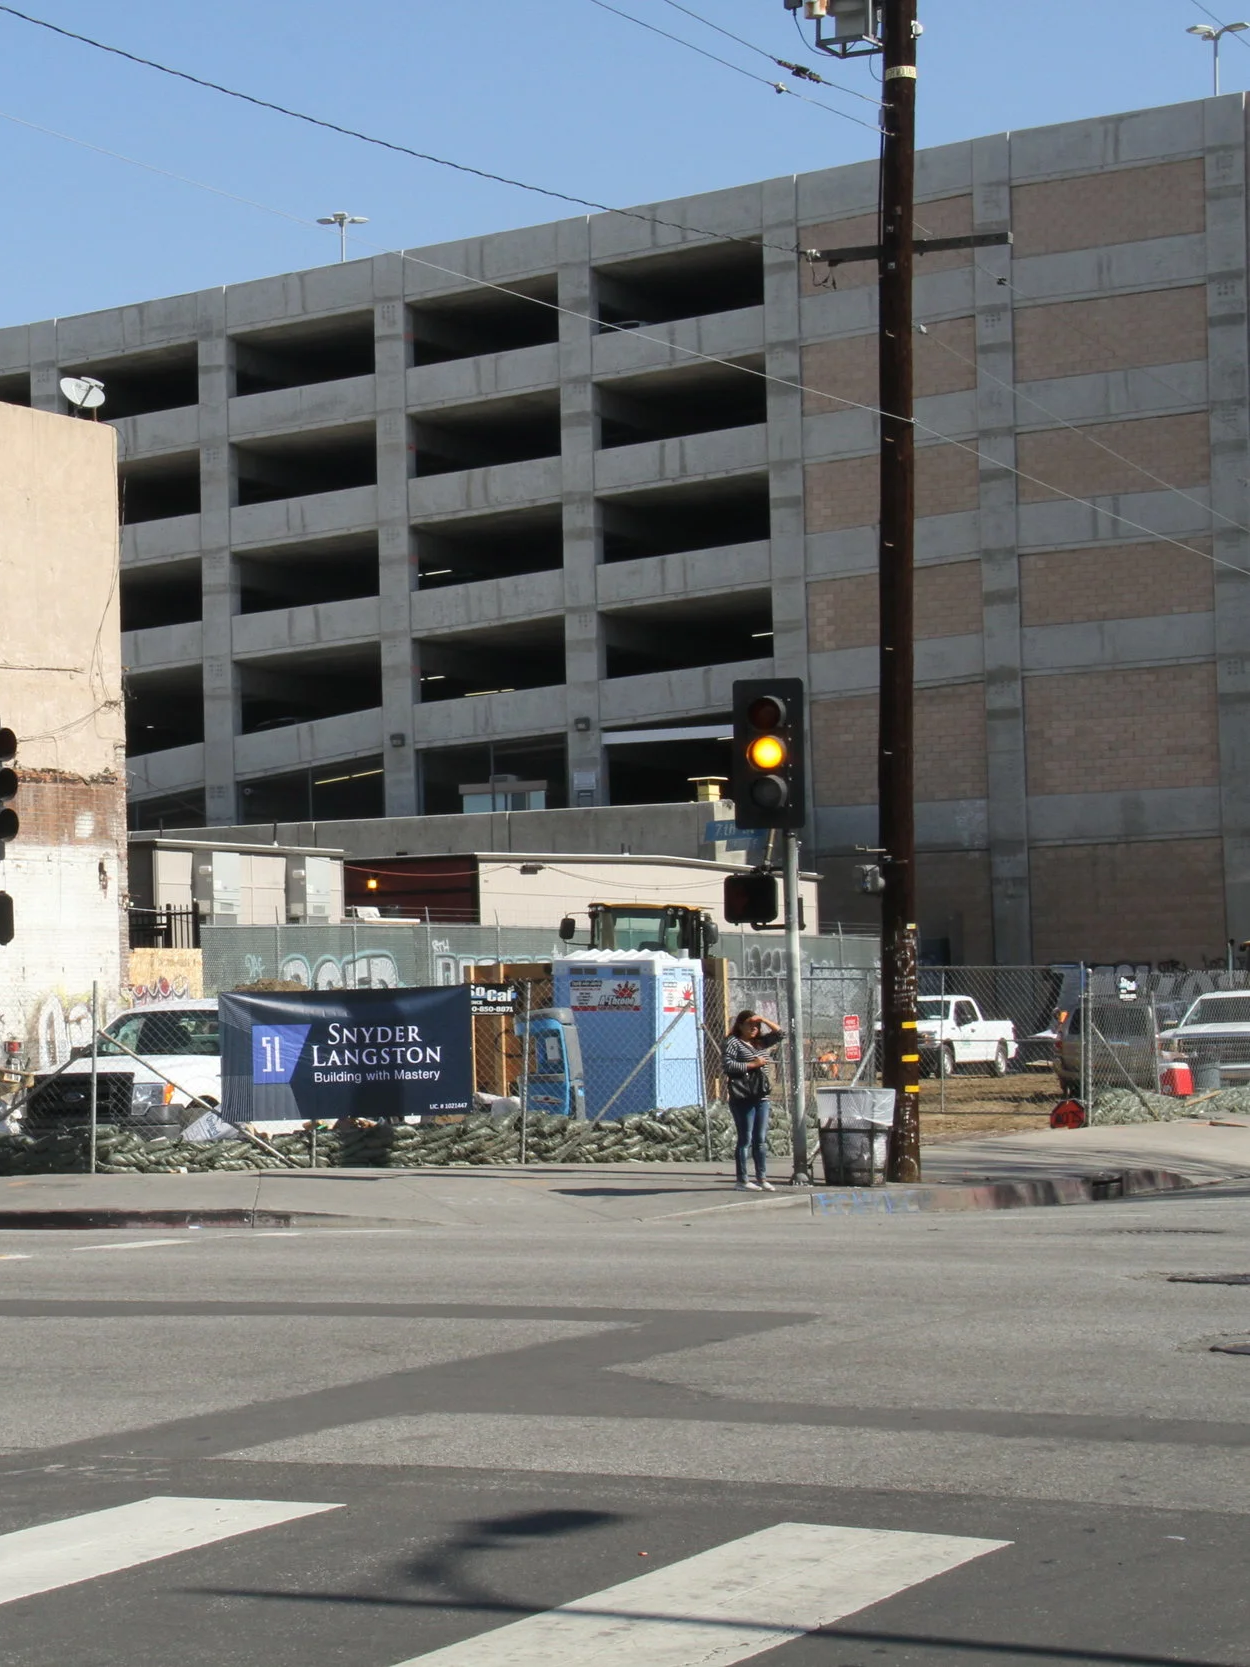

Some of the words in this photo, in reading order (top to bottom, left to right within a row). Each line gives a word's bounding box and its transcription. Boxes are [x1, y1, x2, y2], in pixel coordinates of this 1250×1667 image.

[312, 1045, 441, 1067] LANGSTON
[314, 1071, 362, 1084] Building
[366, 1070, 390, 1081] with
[394, 1068, 440, 1081] Mastery
